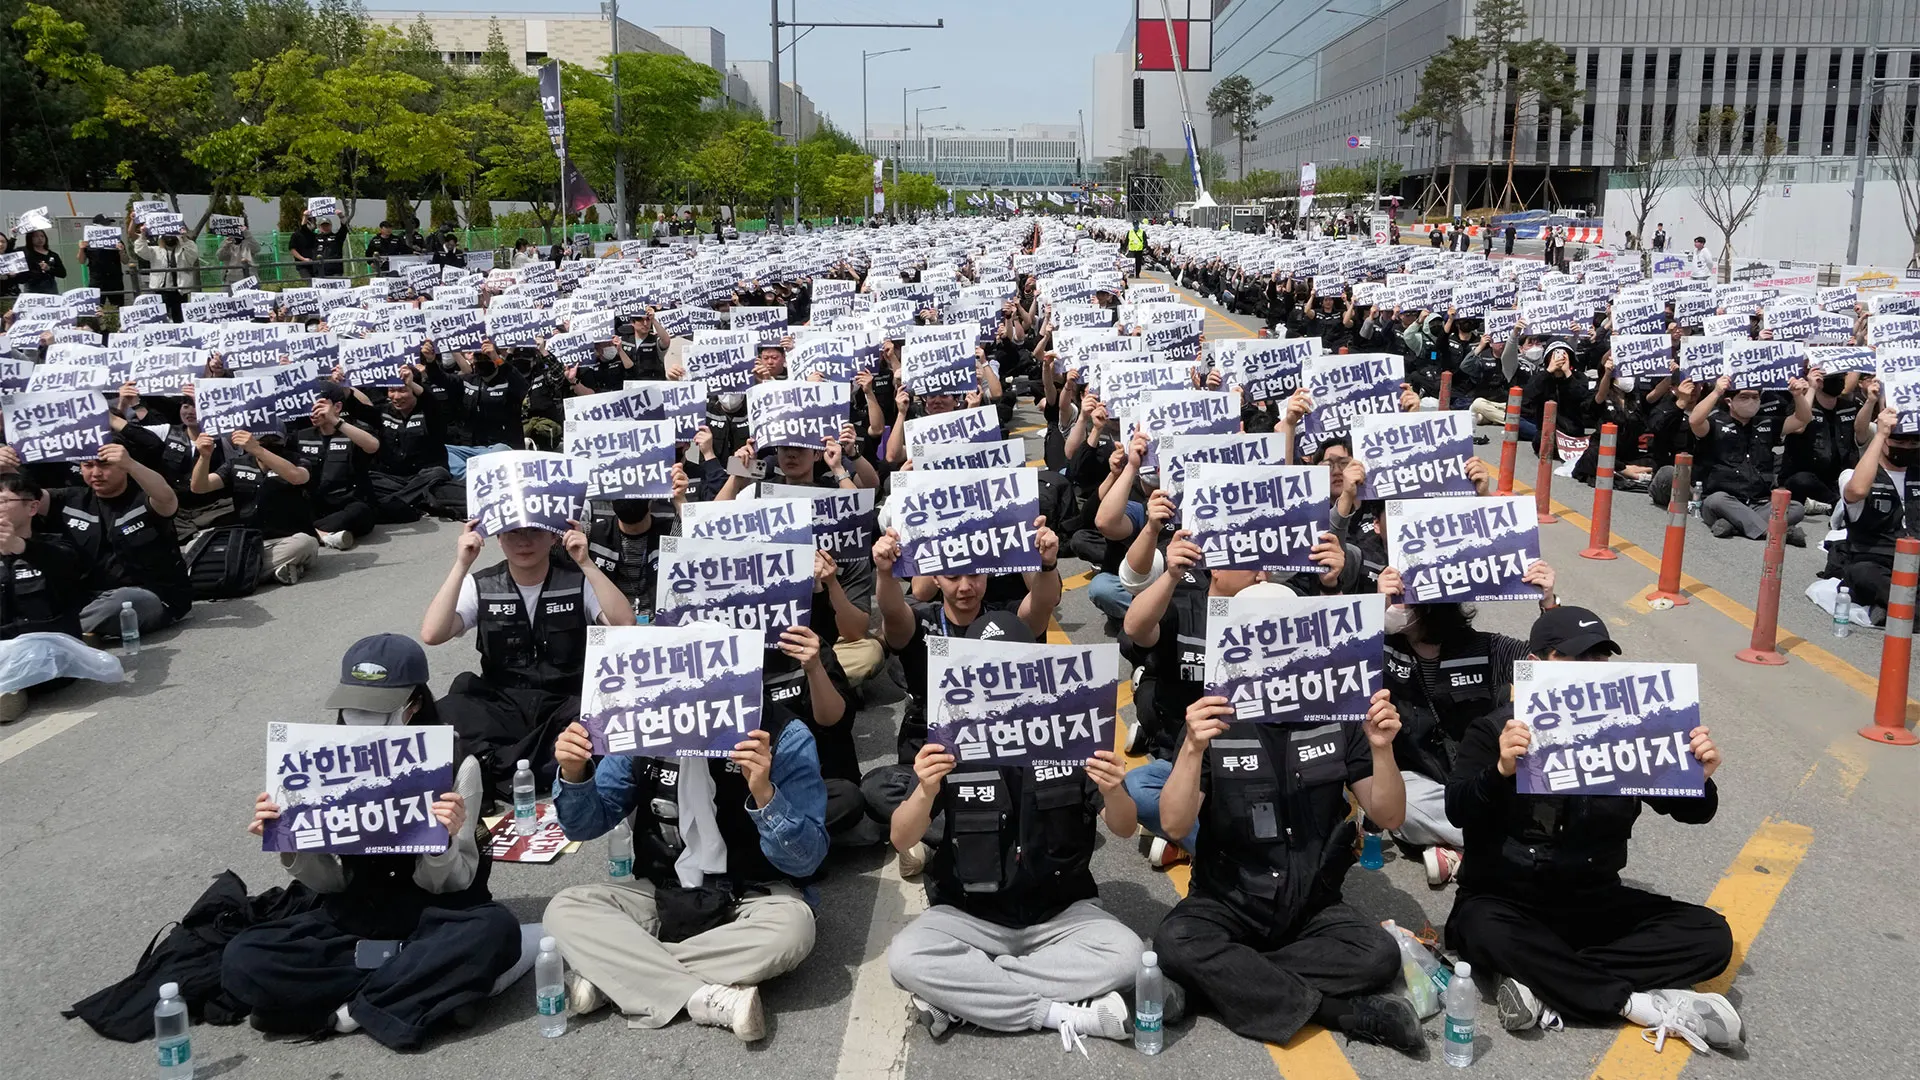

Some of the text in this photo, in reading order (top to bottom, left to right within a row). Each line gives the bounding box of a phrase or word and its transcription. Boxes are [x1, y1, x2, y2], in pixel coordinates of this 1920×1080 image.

[524, 263, 551, 276] 상한폐지
[523, 284, 553, 297] 상한폐지
[609, 288, 644, 301] 상한폐지
[815, 282, 850, 296] 상한폐지
[879, 285, 916, 301] 상한폐지
[1050, 281, 1086, 297] 상한폐지
[1576, 287, 1607, 301] 상한폐지
[1652, 279, 1683, 293] 상한폐지
[1821, 288, 1851, 300] 상한폐지
[287, 291, 321, 303] 상한폐지
[1456, 290, 1491, 304] 상한폐지
[1678, 299, 1713, 313] 상한폐지
[1726, 293, 1757, 304] 상한폐지
[1825, 300, 1855, 311] 실현하자
[1879, 299, 1916, 313] 상한폐지
[123, 306, 160, 323] 상한폐지
[208, 300, 249, 315] 상한폐지
[812, 307, 846, 322] 상한폐지
[947, 307, 989, 325] 상한폐지
[1152, 308, 1198, 324] 상한폐지
[1458, 305, 1493, 318] 실현하자
[1527, 304, 1568, 318] 상한폐지
[1616, 303, 1658, 323] 상한폐지
[1768, 307, 1812, 324] 상한폐지
[430, 311, 477, 333] 상한폐지
[490, 310, 533, 328] 상한폐지
[734, 308, 780, 328] 상한폐지
[1063, 311, 1105, 327] 상한폐지
[1532, 319, 1573, 334] 실현하자
[1707, 317, 1745, 332] 상한폐지
[143, 326, 193, 346] 상한폐지
[224, 328, 278, 346] 상한폐지
[437, 329, 484, 349] 실현하자
[494, 328, 538, 347] 실현하자
[1145, 325, 1193, 346] 상한폐지
[1772, 322, 1818, 340] 실현하자
[343, 342, 395, 364] 상한폐지
[791, 342, 843, 371] 상한폐지
[906, 342, 966, 372] 상한폐지
[1243, 340, 1312, 373] 상한폐지
[1615, 337, 1664, 357] 상한폐지
[1729, 345, 1784, 366] 상한폐지
[135, 352, 196, 373] 상한폐지
[226, 349, 285, 368] 실현하자
[687, 347, 745, 371] 상한폐지
[1620, 356, 1670, 377] 실현하자
[1822, 356, 1876, 373] 실현하자
[32, 369, 95, 390] 상한폐지
[138, 373, 195, 394] 실현하자
[349, 365, 400, 386] 실현하자
[912, 367, 976, 395] 실현하자
[1107, 366, 1173, 392] 상한폐지
[1309, 357, 1393, 398] 상한폐지
[1734, 364, 1791, 389] 실현하자
[198, 379, 263, 410] 상한폐지
[1250, 373, 1301, 400] 실현하
[13, 393, 96, 431] 상한폐지
[750, 385, 820, 420] 상한폐지
[1320, 392, 1400, 432] 실현하자
[203, 406, 276, 436] 실현하자
[1147, 396, 1229, 430] 상한폐지
[571, 424, 661, 458] 상한폐지
[756, 418, 831, 446] 실현하자
[1361, 415, 1457, 459] 상한폐지
[21, 425, 111, 462] 실현하자
[236, 471, 257, 480] 투쟁
[1373, 454, 1467, 498] 실현하자
[812, 492, 861, 519] 폐지
[900, 473, 1020, 526] 상한폐지
[1191, 471, 1312, 520] 상한폐지
[67, 517, 90, 531] 투쟁
[481, 495, 583, 536] 실현하자
[692, 502, 796, 541] 상한폐지
[122, 522, 145, 536] SELU
[1398, 500, 1518, 554] 상한폐지
[914, 521, 1036, 574] 실현하자
[1202, 521, 1328, 567] 실현하자
[595, 557, 616, 573] 투쟁
[667, 549, 796, 594] 상한폐지
[1413, 549, 1540, 601] 실현하자
[488, 603, 516, 615] 투쟁
[546, 603, 574, 614] SELU
[980, 630, 1005, 640] adidas
[1218, 601, 1363, 663] 상한폐지
[594, 635, 739, 693] 상한폐지
[1387, 659, 1411, 678] 투쟁
[939, 650, 1093, 705] 상한폐지
[1450, 672, 1483, 687] SELU
[771, 686, 801, 701] SELU
[1231, 660, 1383, 720] 실현하자
[1526, 669, 1675, 731] 상한폐지
[604, 695, 762, 753] 실현하자
[954, 707, 1115, 761] 실현하자
[277, 732, 427, 791] 상한폐지
[1298, 742, 1336, 762] SELU
[1543, 731, 1693, 792] 실현하자
[1222, 754, 1259, 771] 투쟁
[1035, 766, 1072, 782] SELU
[957, 786, 995, 802] 투쟁
[290, 791, 437, 850] 실현하자
